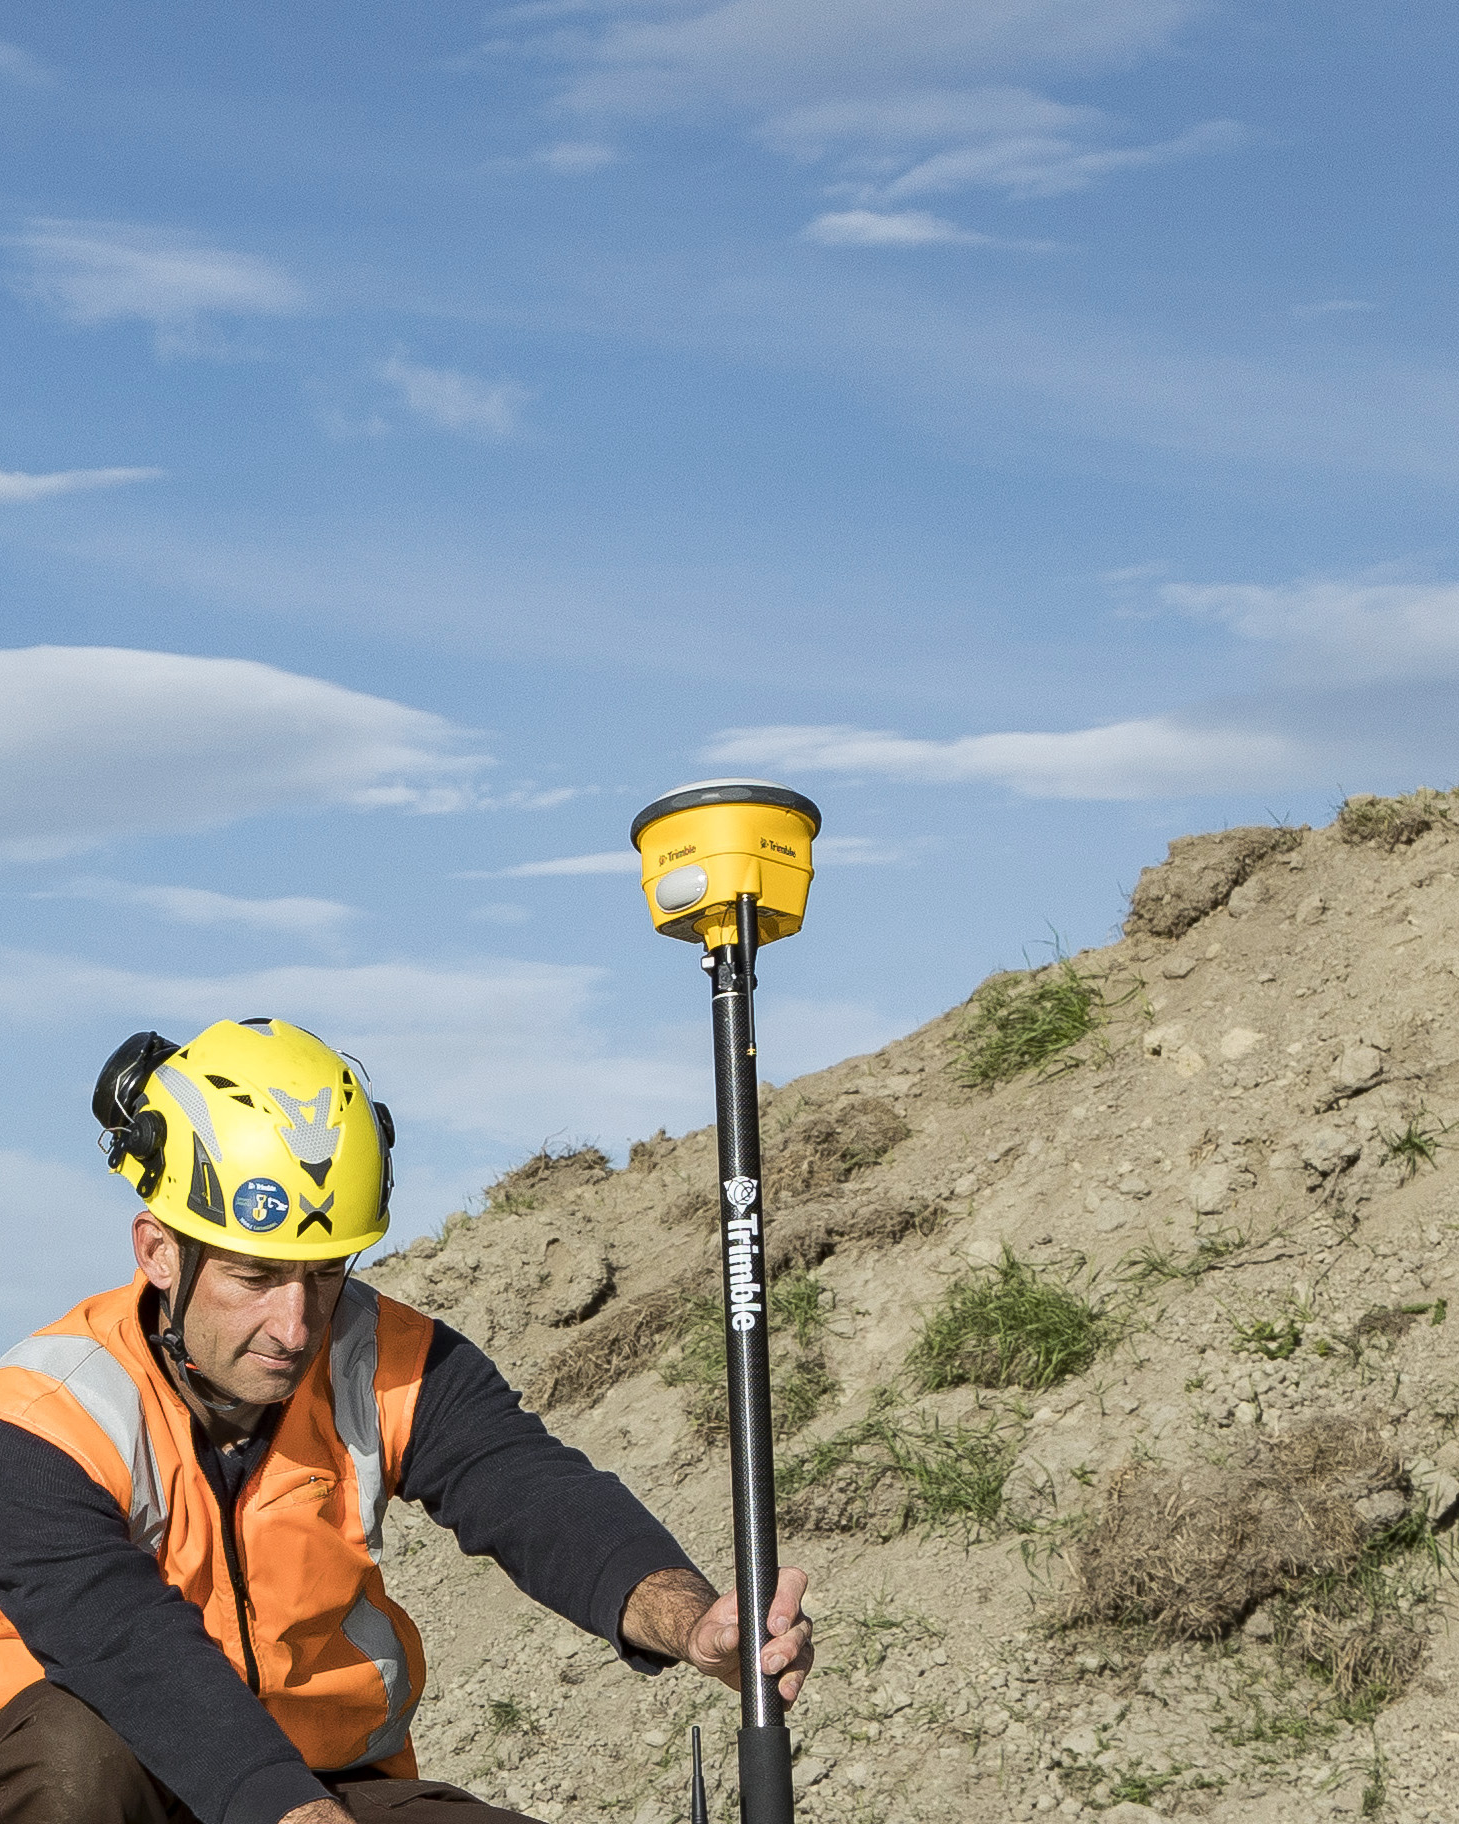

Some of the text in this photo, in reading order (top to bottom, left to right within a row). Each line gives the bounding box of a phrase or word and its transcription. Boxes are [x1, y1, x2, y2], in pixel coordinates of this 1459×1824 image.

[668, 845, 696, 861] Trimble
[769, 840, 796, 858] Trimble
[728, 1213, 762, 1331] Trimble
